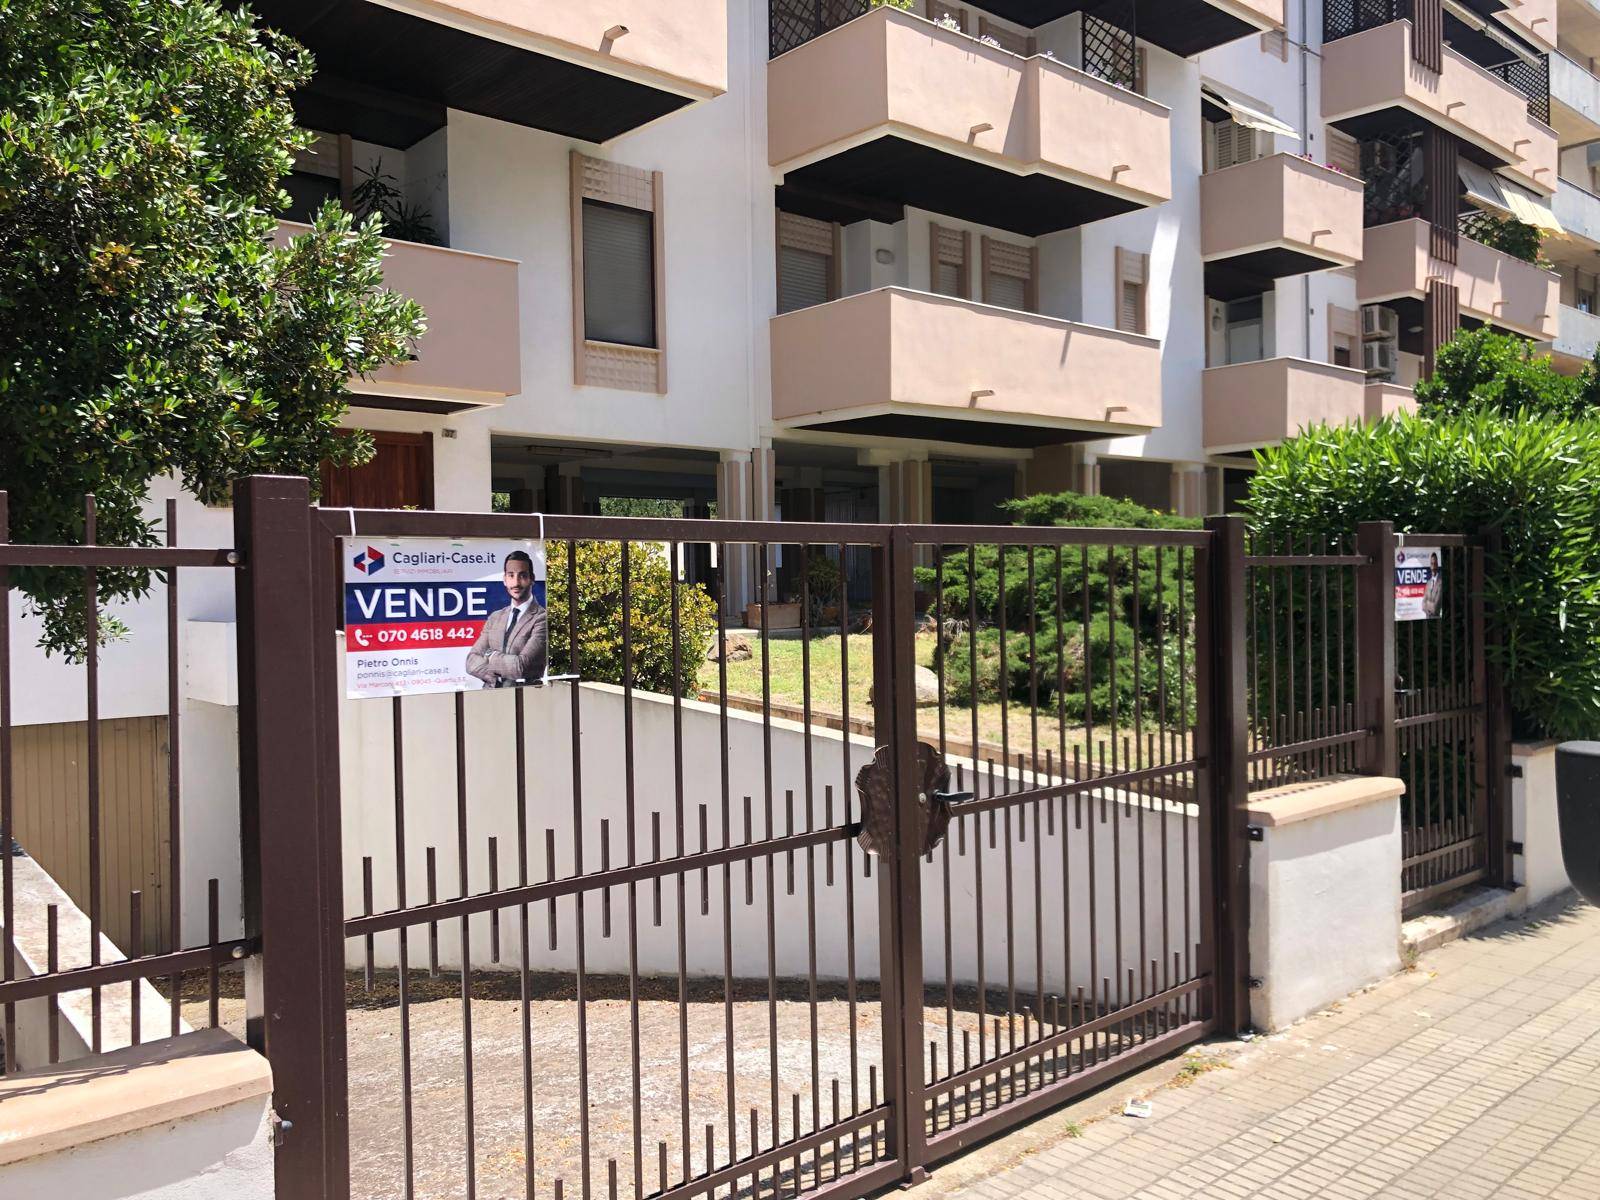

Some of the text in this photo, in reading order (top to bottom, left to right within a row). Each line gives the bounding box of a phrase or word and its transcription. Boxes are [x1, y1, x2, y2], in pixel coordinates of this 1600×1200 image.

[392, 552, 496, 566] Cagliari-Case.it
[1397, 569, 1428, 585] VENDE
[354, 587, 488, 619] VENDE
[377, 627, 475, 643] 070 4618 442
[357, 657, 419, 668] Pietro Onnis
